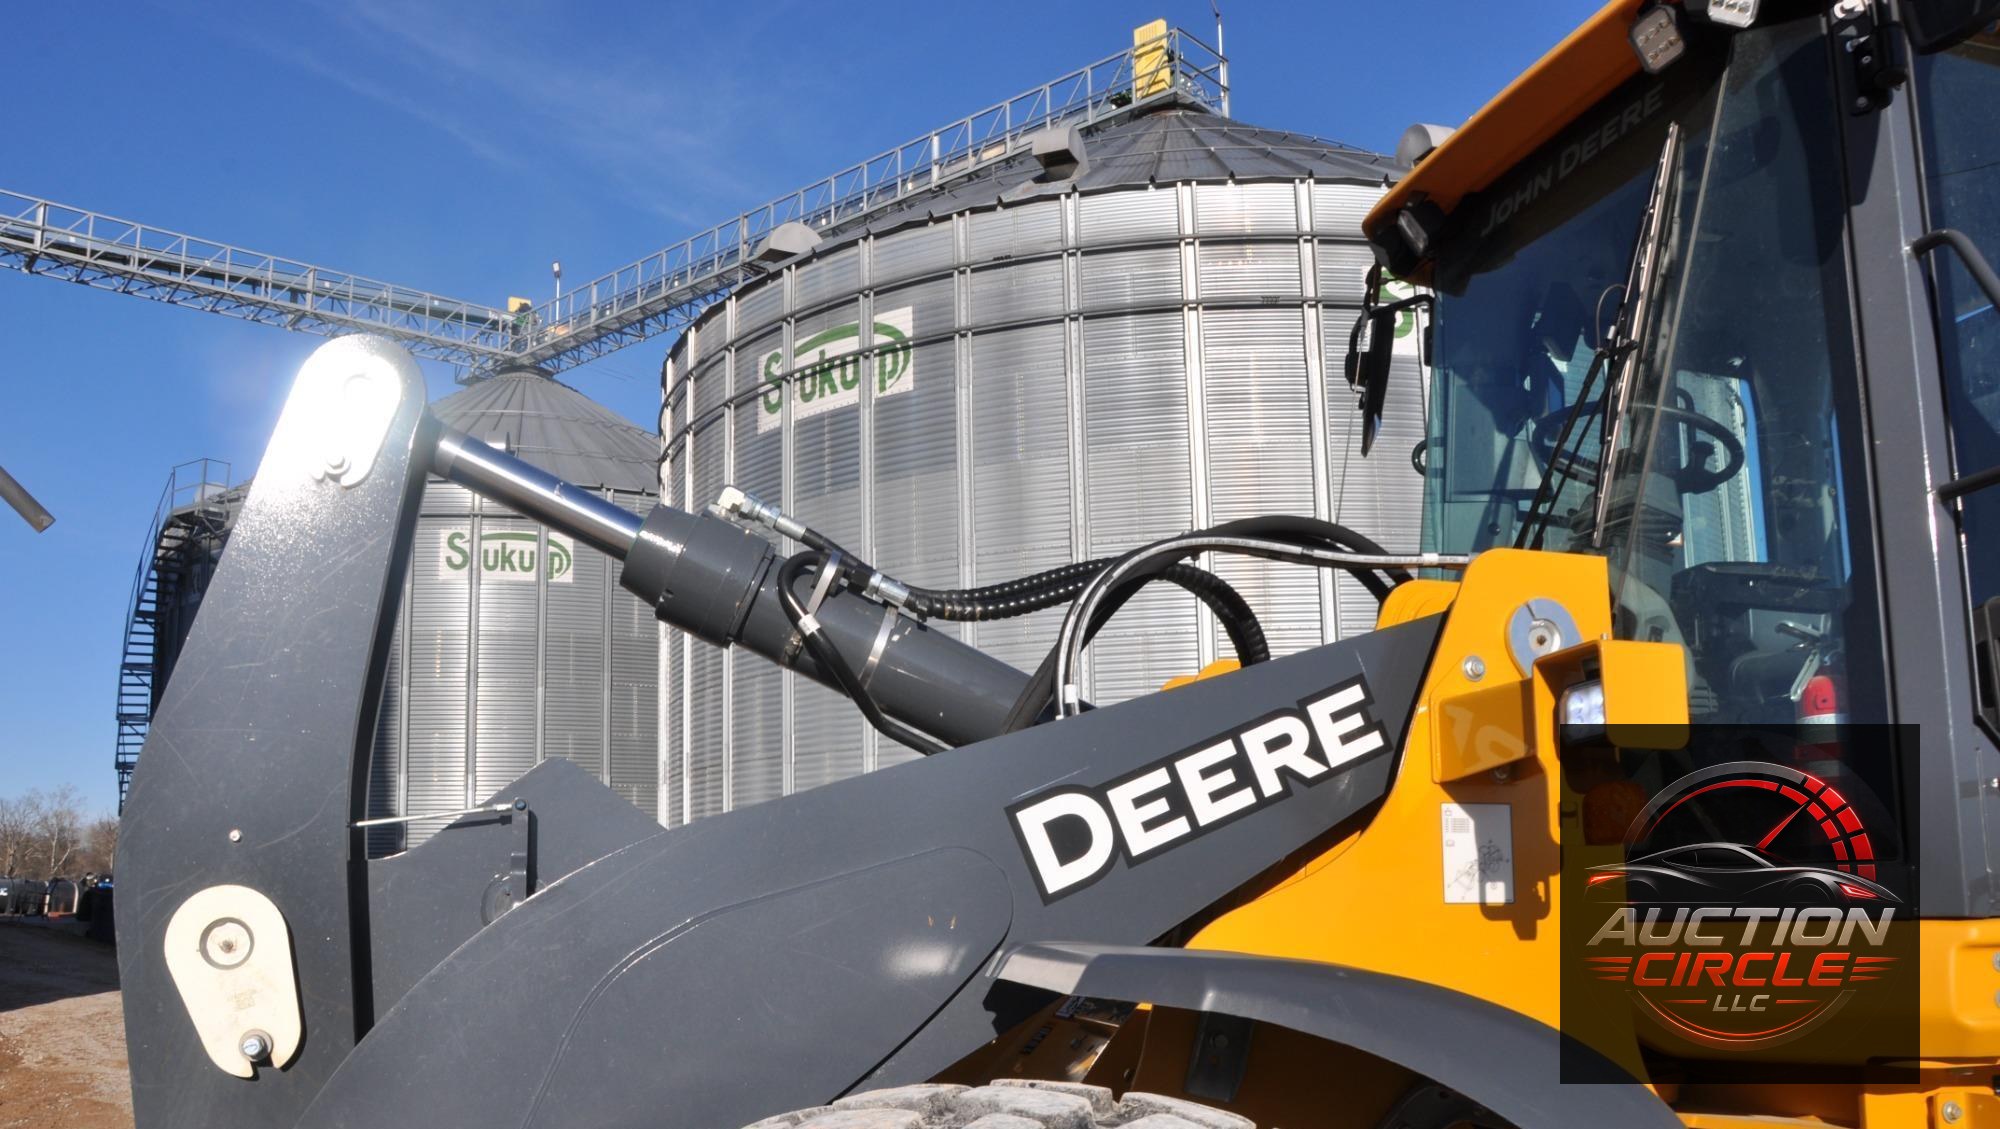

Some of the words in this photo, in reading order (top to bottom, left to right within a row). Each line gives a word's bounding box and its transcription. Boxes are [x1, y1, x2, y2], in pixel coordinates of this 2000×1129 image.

[1481, 168, 1551, 235] JOHN
[1558, 84, 1663, 180] DEERE
[1015, 683, 1384, 895] DEERE
